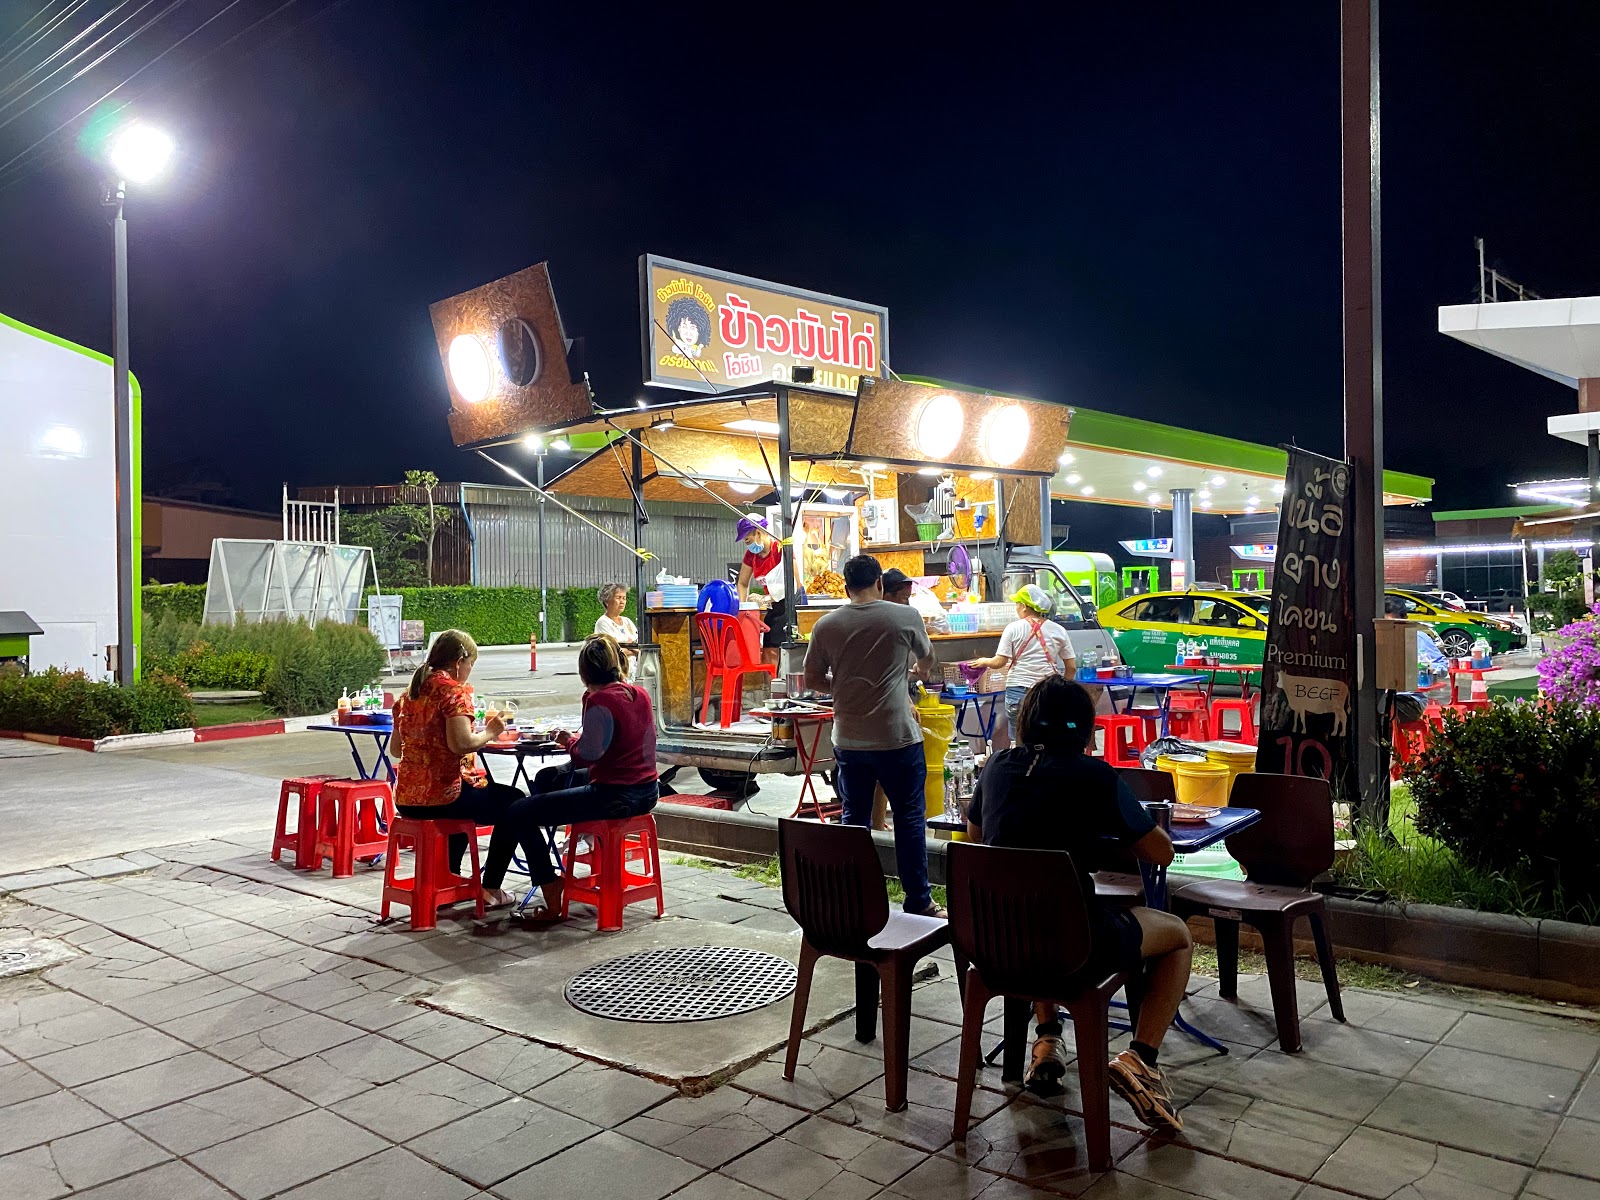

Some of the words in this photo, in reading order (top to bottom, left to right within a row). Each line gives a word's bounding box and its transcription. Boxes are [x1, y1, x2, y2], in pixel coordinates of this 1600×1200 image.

[718, 293, 875, 371] ข้าวมันไก่
[723, 352, 762, 379] โอชิน
[1282, 540, 1341, 590] ย่าง
[1278, 593, 1338, 646] โคขุน
[1266, 643, 1347, 670] Premium
[1295, 684, 1340, 701] BEEF
